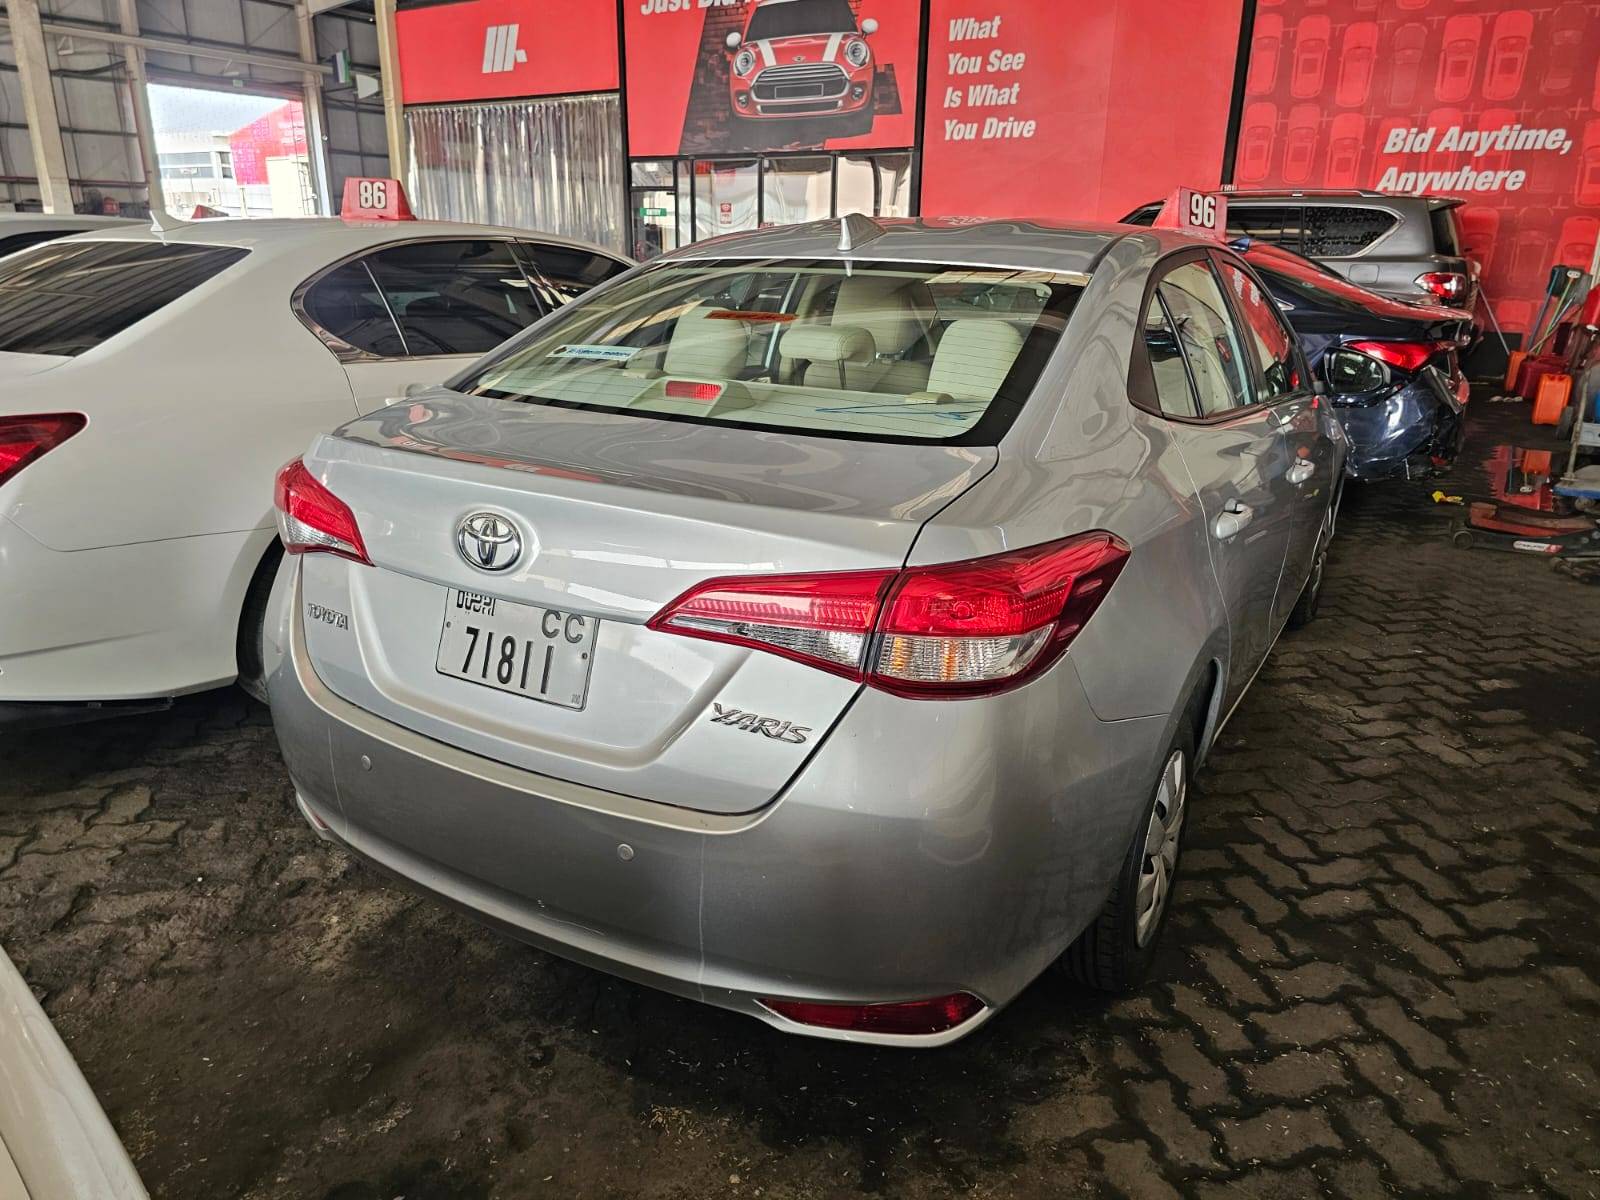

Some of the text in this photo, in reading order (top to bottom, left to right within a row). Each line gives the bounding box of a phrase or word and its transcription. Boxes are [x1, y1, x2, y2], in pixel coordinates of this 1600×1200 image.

[948, 15, 1002, 42] What
[948, 49, 1026, 75] You See
[943, 82, 1020, 108] Is What
[944, 116, 1037, 141] You Drive
[1382, 124, 1572, 157] Bid Anytime,
[1376, 165, 1526, 195] Anywhere
[359, 181, 386, 209] 86
[1190, 193, 1216, 228] 96
[307, 602, 349, 631] TOYOTA
[541, 608, 585, 644] CC
[461, 626, 555, 695] 71811
[709, 702, 814, 744] YARIS
